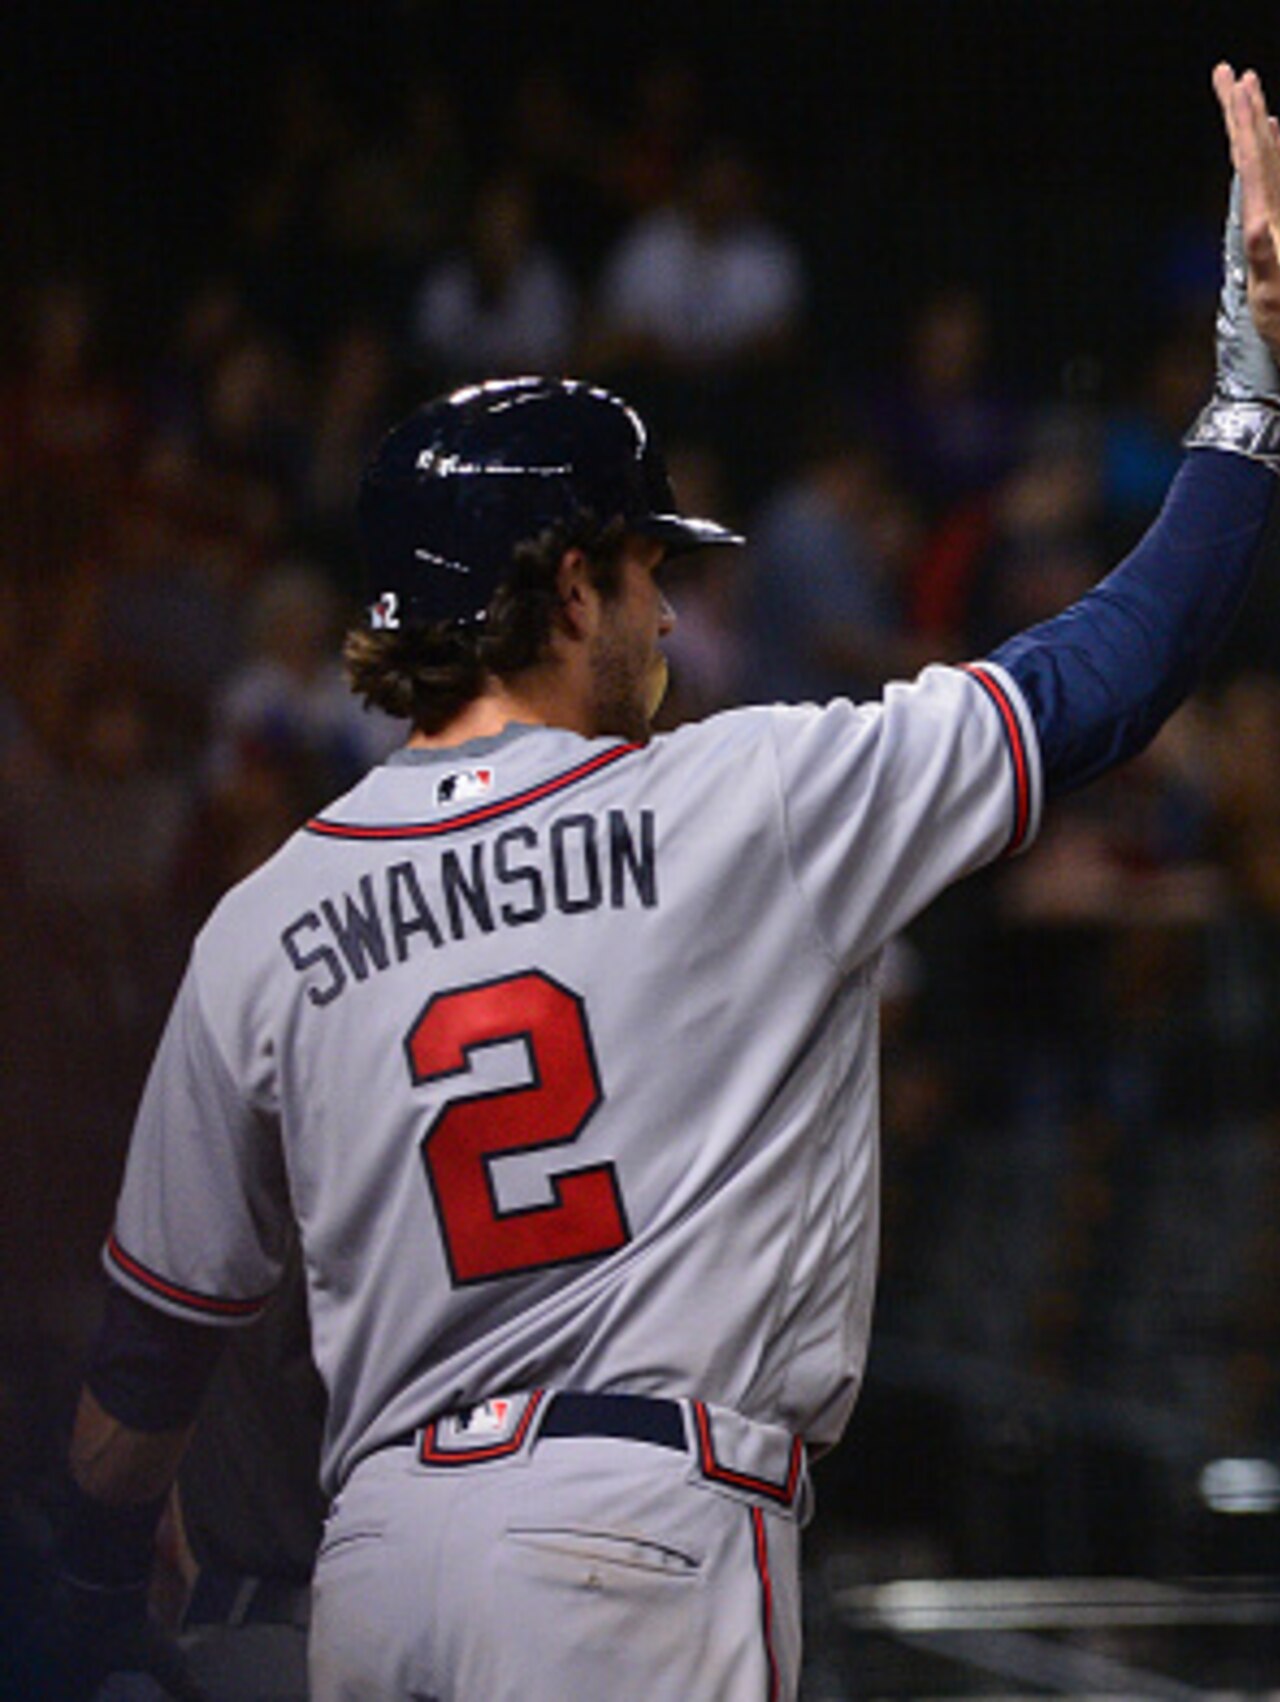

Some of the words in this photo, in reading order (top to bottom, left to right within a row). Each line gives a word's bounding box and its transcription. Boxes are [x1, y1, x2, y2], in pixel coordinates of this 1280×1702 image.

[381, 592, 400, 628] 2
[279, 808, 659, 1008] SWANSON
[403, 966, 633, 1291] 2
